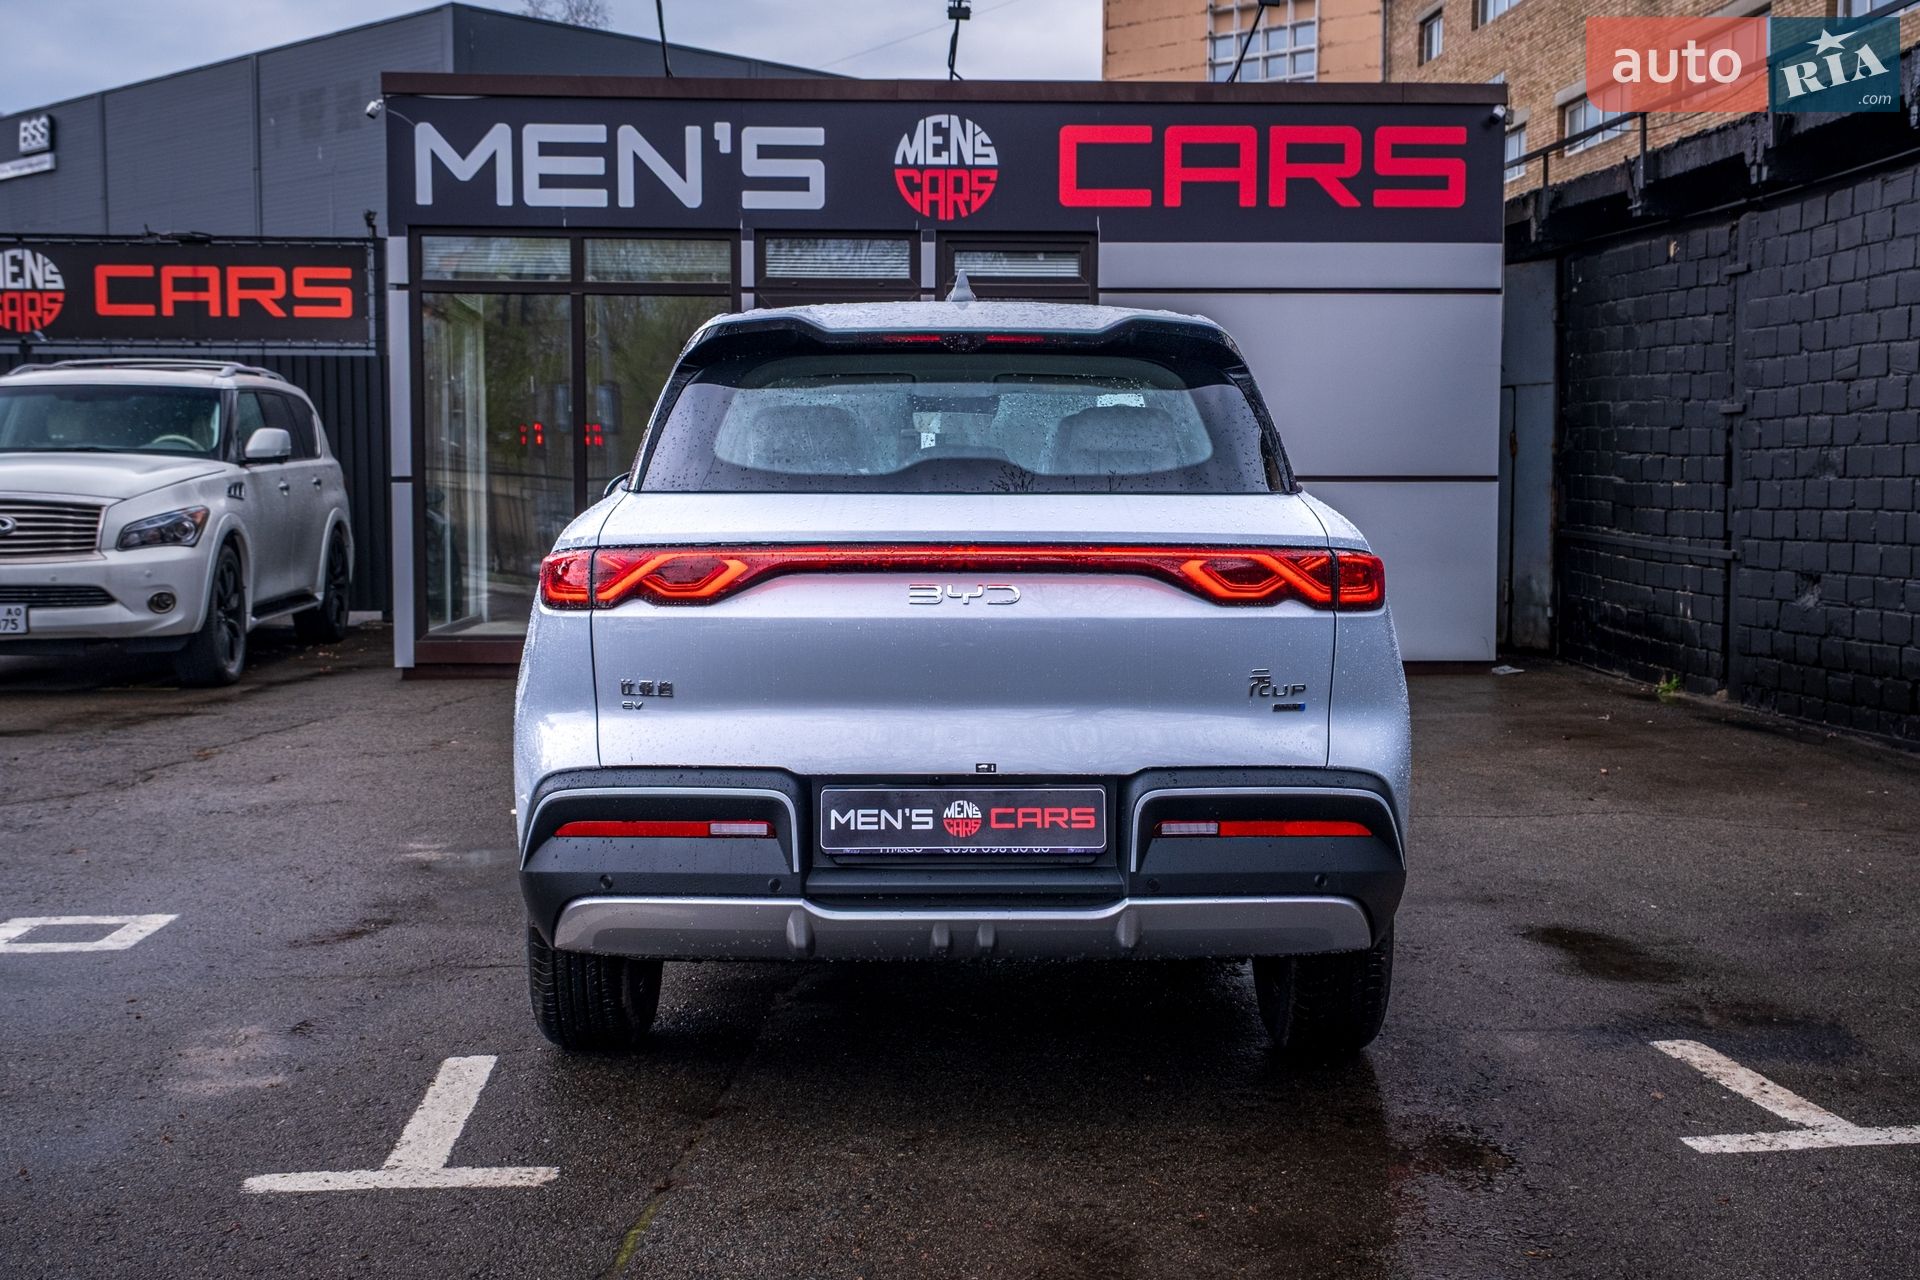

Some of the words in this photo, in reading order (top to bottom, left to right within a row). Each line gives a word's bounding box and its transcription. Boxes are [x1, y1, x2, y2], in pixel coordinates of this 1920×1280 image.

[19, 115, 49, 152] BSS
[894, 114, 998, 165] MEN'S
[415, 121, 825, 210] MEN'S
[1058, 124, 1468, 209] CARS
[894, 169, 998, 221] CARS
[0, 249, 65, 290] EN'S
[94, 264, 353, 319] CARS
[0, 291, 65, 333] ARS
[909, 584, 1021, 605] BYD
[0, 618, 19, 631] 75
[622, 700, 643, 710] EV
[830, 807, 934, 831] MEN'S
[989, 806, 1097, 830] CARS
[942, 799, 983, 819] MEN'S
[942, 818, 983, 838] CARS
